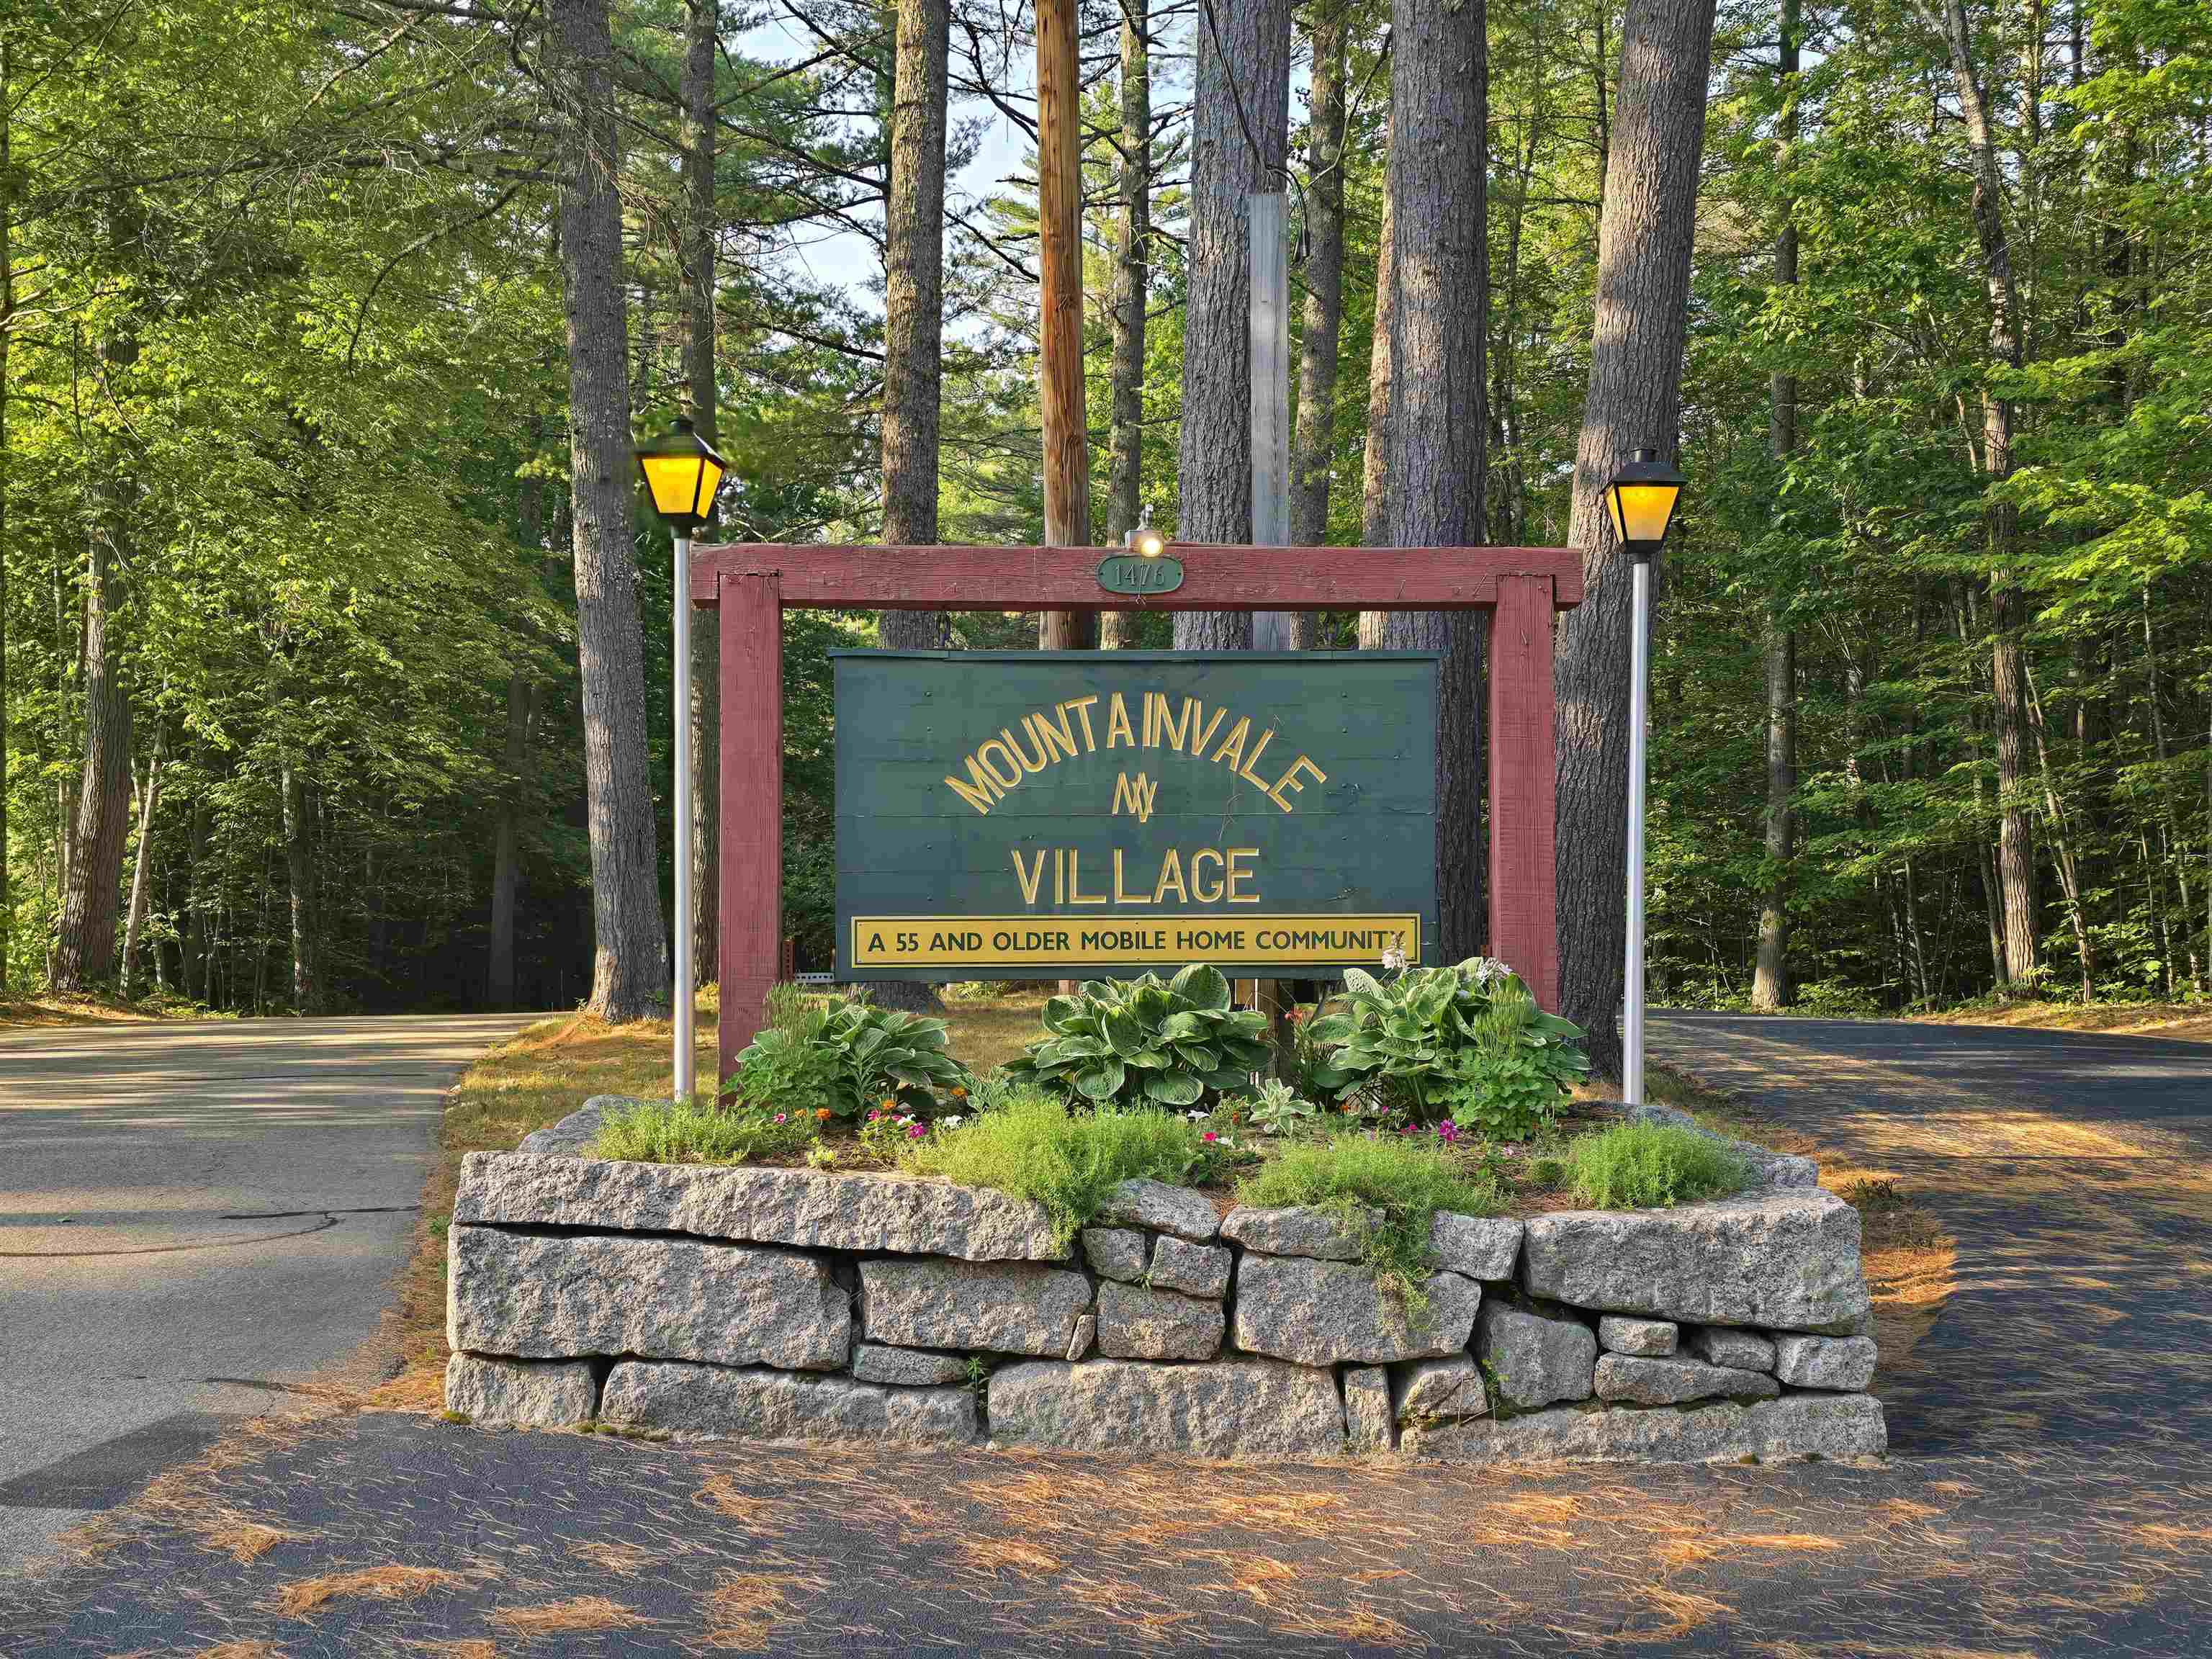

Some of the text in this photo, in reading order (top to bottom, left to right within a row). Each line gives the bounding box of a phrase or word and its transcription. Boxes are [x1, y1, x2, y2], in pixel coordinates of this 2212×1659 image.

[1112, 564, 1164, 587] 1476
[944, 691, 1327, 816] MOUNTAINVALE
[1011, 847, 1260, 904] VILLAGE
[868, 932, 886, 951] A
[896, 932, 919, 950] 55
[930, 932, 983, 950] AND
[993, 932, 1070, 951] OLDER
[1081, 931, 1166, 950] MOBILE
[1177, 930, 1245, 950] HOME
